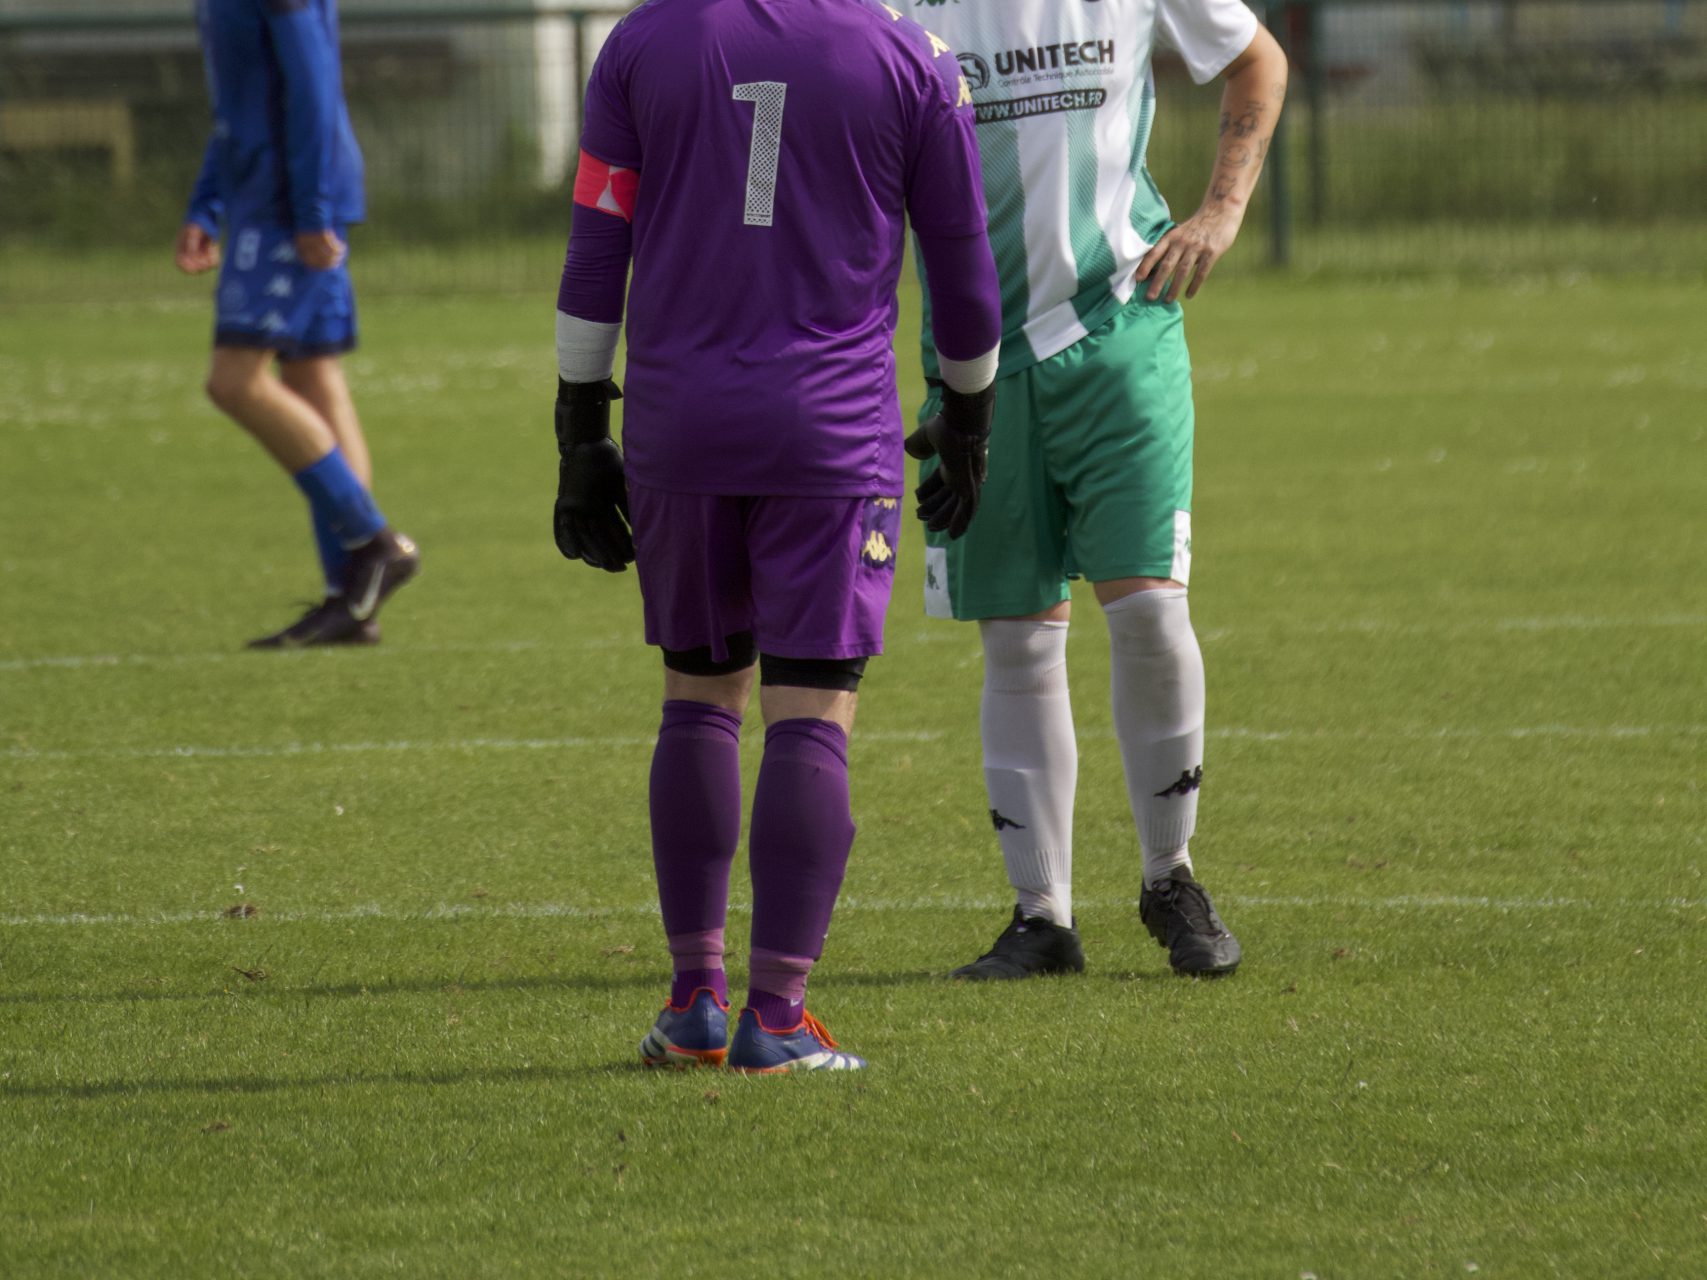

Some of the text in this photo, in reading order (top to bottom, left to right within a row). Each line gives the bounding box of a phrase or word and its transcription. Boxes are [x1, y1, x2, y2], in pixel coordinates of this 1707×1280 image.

[994, 39, 1114, 76] UNITECH
[976, 91, 1103, 120] WW.UNITECH.FR
[732, 80, 788, 227] 1
